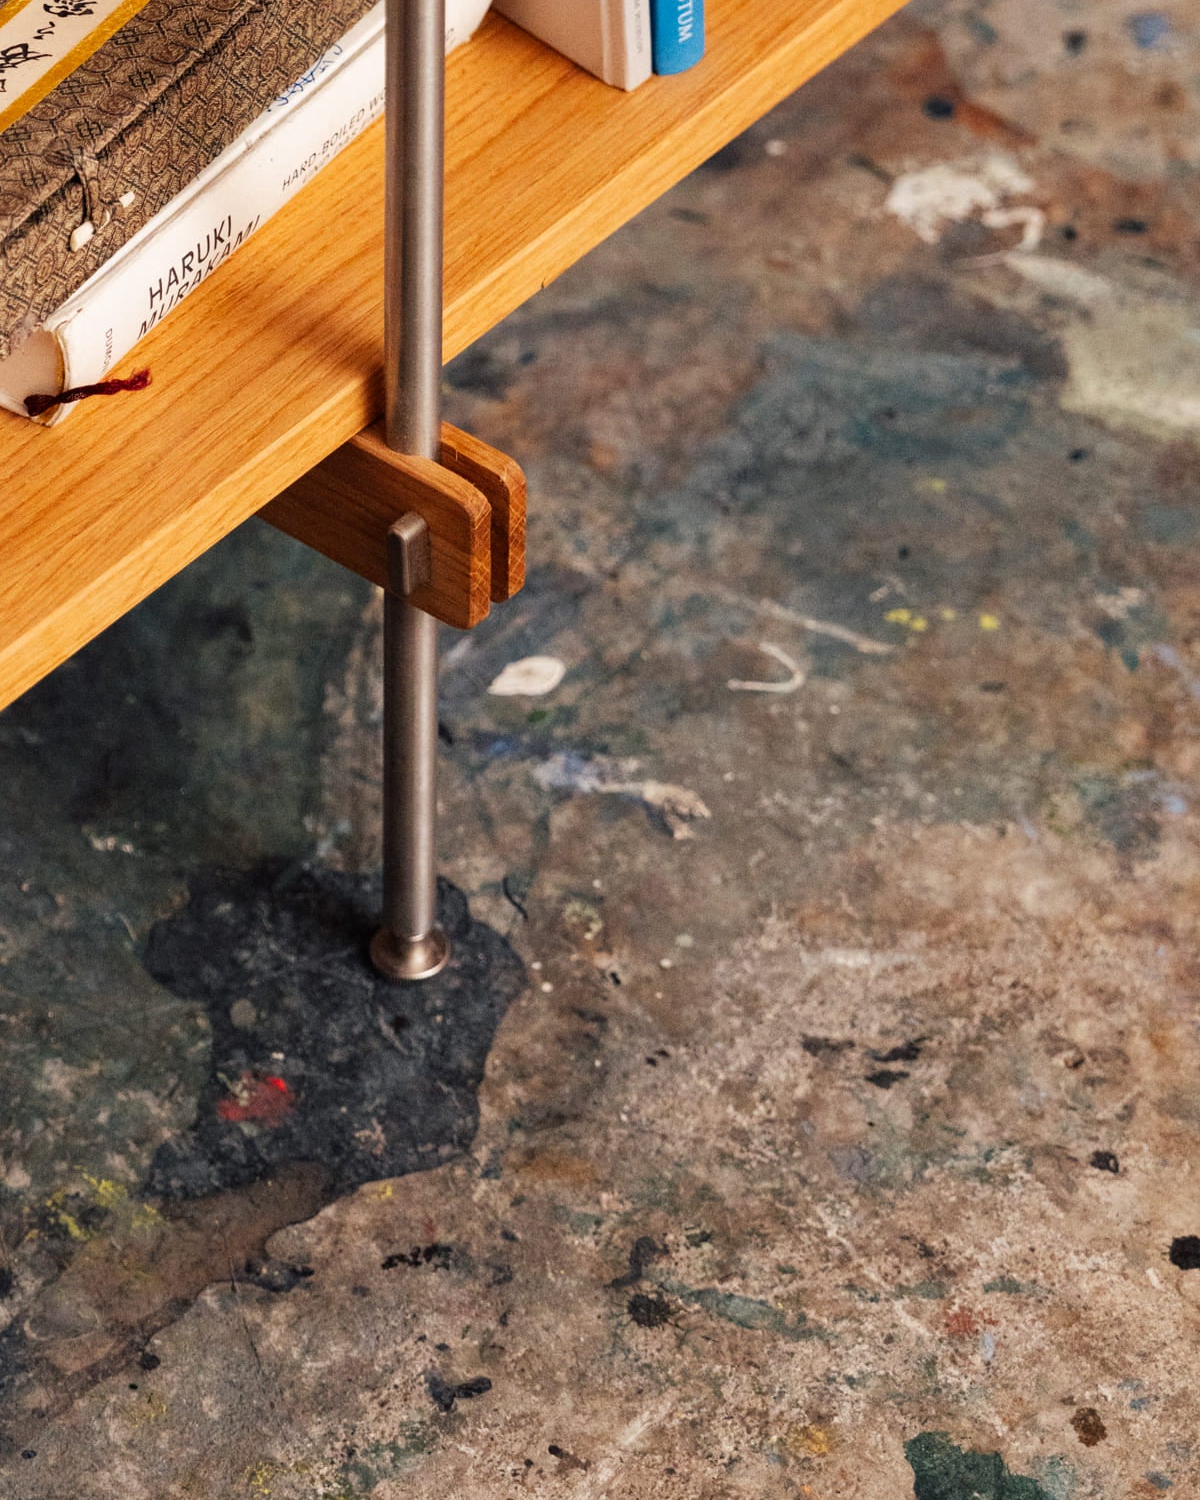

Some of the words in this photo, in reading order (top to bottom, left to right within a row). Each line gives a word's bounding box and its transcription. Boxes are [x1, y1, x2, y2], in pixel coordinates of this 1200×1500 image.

[282, 108, 366, 192] HARD-BOILED
[137, 214, 261, 341] MURAKAMI
[149, 214, 233, 309] HARUKI
